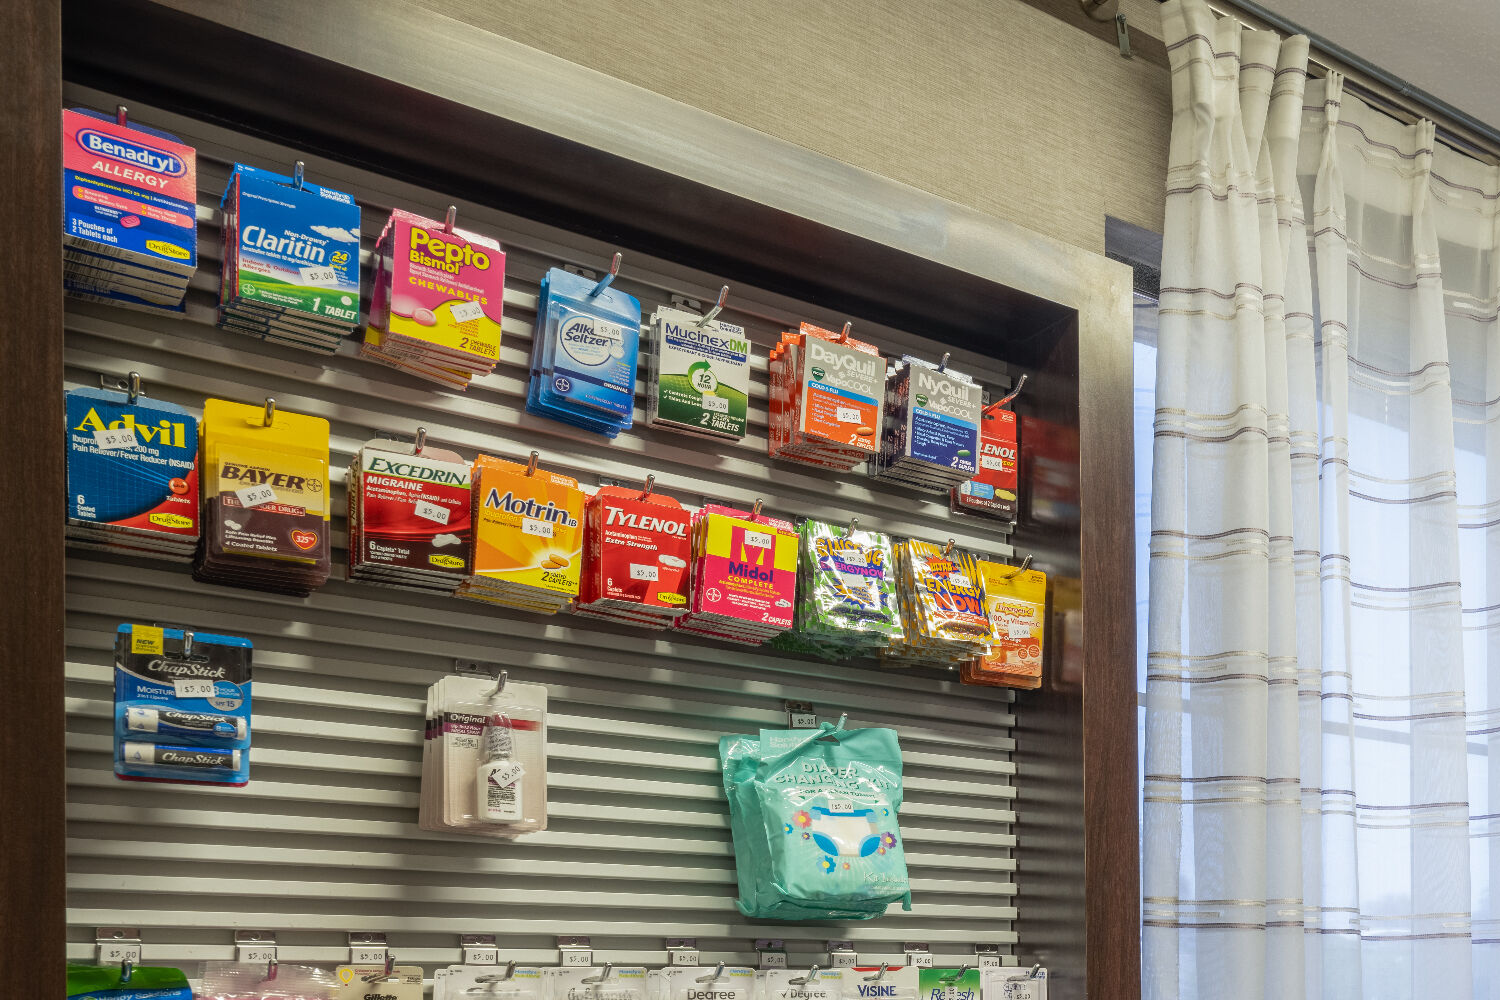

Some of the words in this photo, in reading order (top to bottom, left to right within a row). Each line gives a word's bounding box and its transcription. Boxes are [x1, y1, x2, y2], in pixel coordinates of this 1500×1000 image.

[89, 134, 174, 172] Benadryl
[92, 161, 168, 189] ALLERGY
[72, 218, 77, 226] 3
[78, 219, 105, 232] Pouches
[78, 226, 101, 239] Tablets
[103, 233, 118, 243] each
[242, 226, 325, 263] Claritin
[411, 227, 490, 270] Pepto
[333, 251, 348, 260] 24
[410, 250, 460, 274] Bismol
[310, 272, 334, 280] $5.00
[409, 277, 488, 305] CHEWABLES
[313, 297, 321, 311] 1
[325, 305, 357, 320] TABLET
[460, 338, 468, 349] 2
[565, 332, 608, 346] Seltzer
[666, 323, 730, 348] Mucinex
[730, 339, 747, 354] DM
[469, 345, 495, 356] TABLETS
[811, 344, 875, 376] DayQuil
[700, 374, 711, 384] 12
[825, 372, 873, 395] VapoCOOL
[919, 373, 969, 400] NyQuil
[928, 398, 972, 419] VapoCOOL
[73, 407, 186, 449] Advil
[700, 413, 710, 425] 2
[711, 420, 739, 431] TABLETS
[106, 434, 133, 445] $5.00
[848, 434, 857, 445] 2
[72, 444, 87, 452] Pain
[140, 455, 167, 464] Reducer
[169, 457, 194, 470] (NSAID)
[980, 442, 1015, 460] LENOL
[951, 456, 958, 467] 2
[221, 465, 305, 490] BAYER
[368, 457, 467, 485] EXCEDRIN
[366, 475, 423, 492] MIGRAINE
[77, 495, 85, 504] 6
[247, 490, 272, 501] $5.00
[77, 511, 96, 519] Tablets
[423, 508, 447, 520] $5.00
[485, 489, 569, 524] Motrin
[605, 506, 687, 537] TYLENOL
[605, 537, 625, 545] Extra
[626, 540, 658, 551] Strength
[541, 571, 549, 582] 2
[728, 562, 773, 583] Midol
[607, 578, 612, 586] 6
[728, 575, 774, 590] COMPLETE
[926, 578, 981, 599] ENERGY
[934, 594, 981, 614] NOW
[762, 613, 768, 622] 2
[768, 616, 792, 626] CAPLETS
[148, 660, 226, 678] ChapStick
[450, 714, 486, 723] Original
[162, 753, 225, 765] ChapStick
[110, 950, 137, 959] $5.00
[248, 952, 272, 960] $5.00
[135, 989, 182, 1000] Solutions
[857, 985, 896, 997] VISINE
